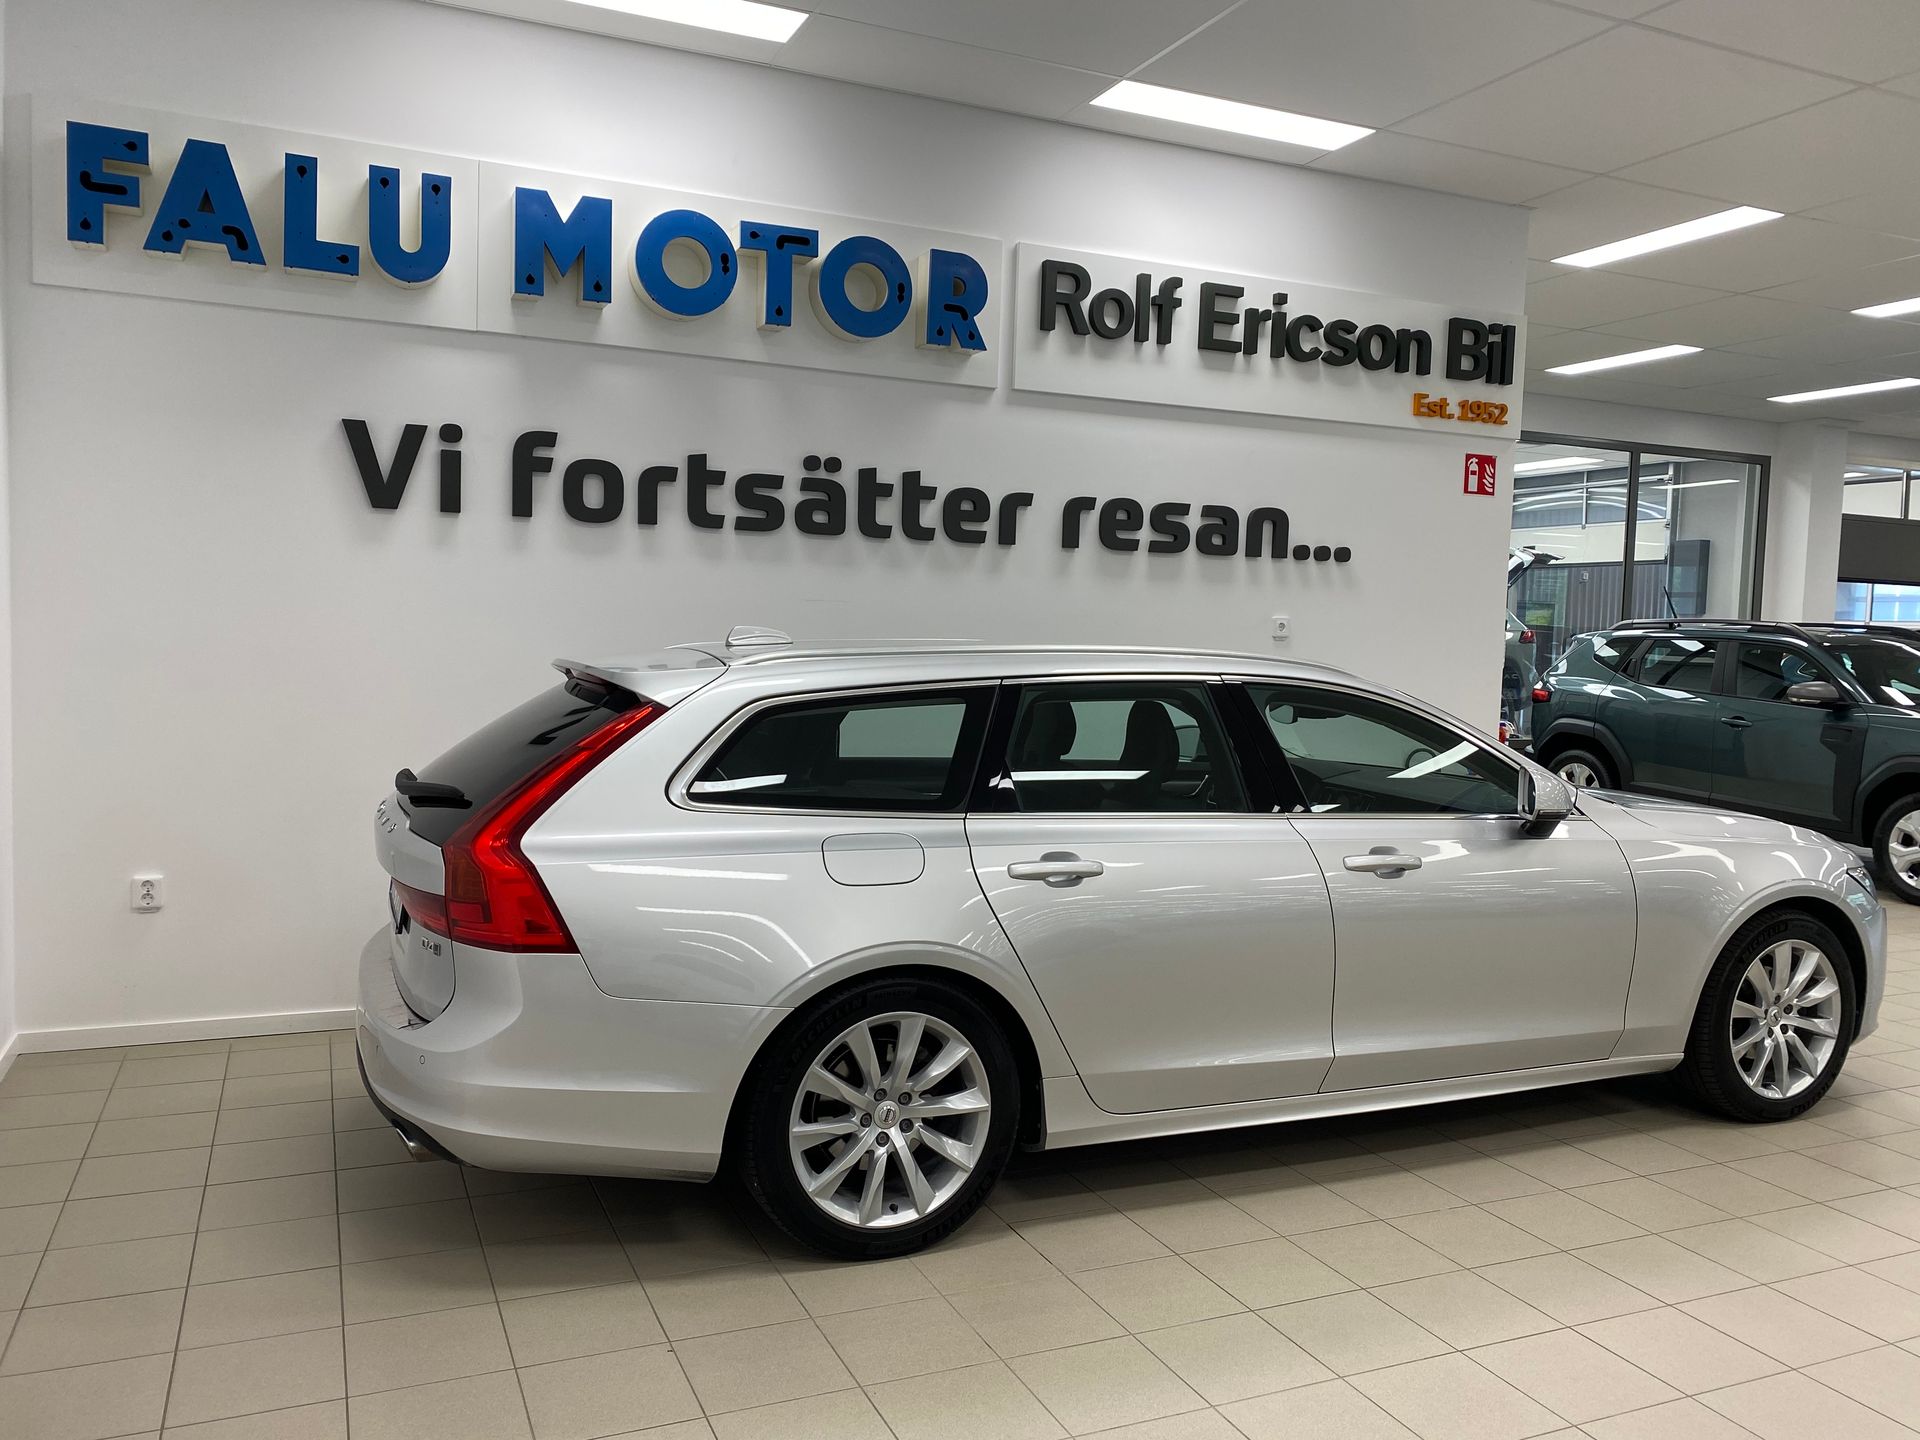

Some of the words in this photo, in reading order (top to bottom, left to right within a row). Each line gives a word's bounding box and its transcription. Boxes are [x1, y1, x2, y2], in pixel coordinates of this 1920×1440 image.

[66, 120, 452, 287] FALU
[511, 186, 988, 355] MOTOR
[1039, 259, 1183, 346] Rolf
[1197, 281, 1433, 373] Ericson
[1445, 316, 1516, 387] Bil
[1412, 392, 1455, 420] Est.
[1456, 399, 1509, 425] 1952
[341, 418, 463, 514] Vi
[511, 430, 1035, 546] fortsätter
[1061, 496, 1352, 563] resan...
